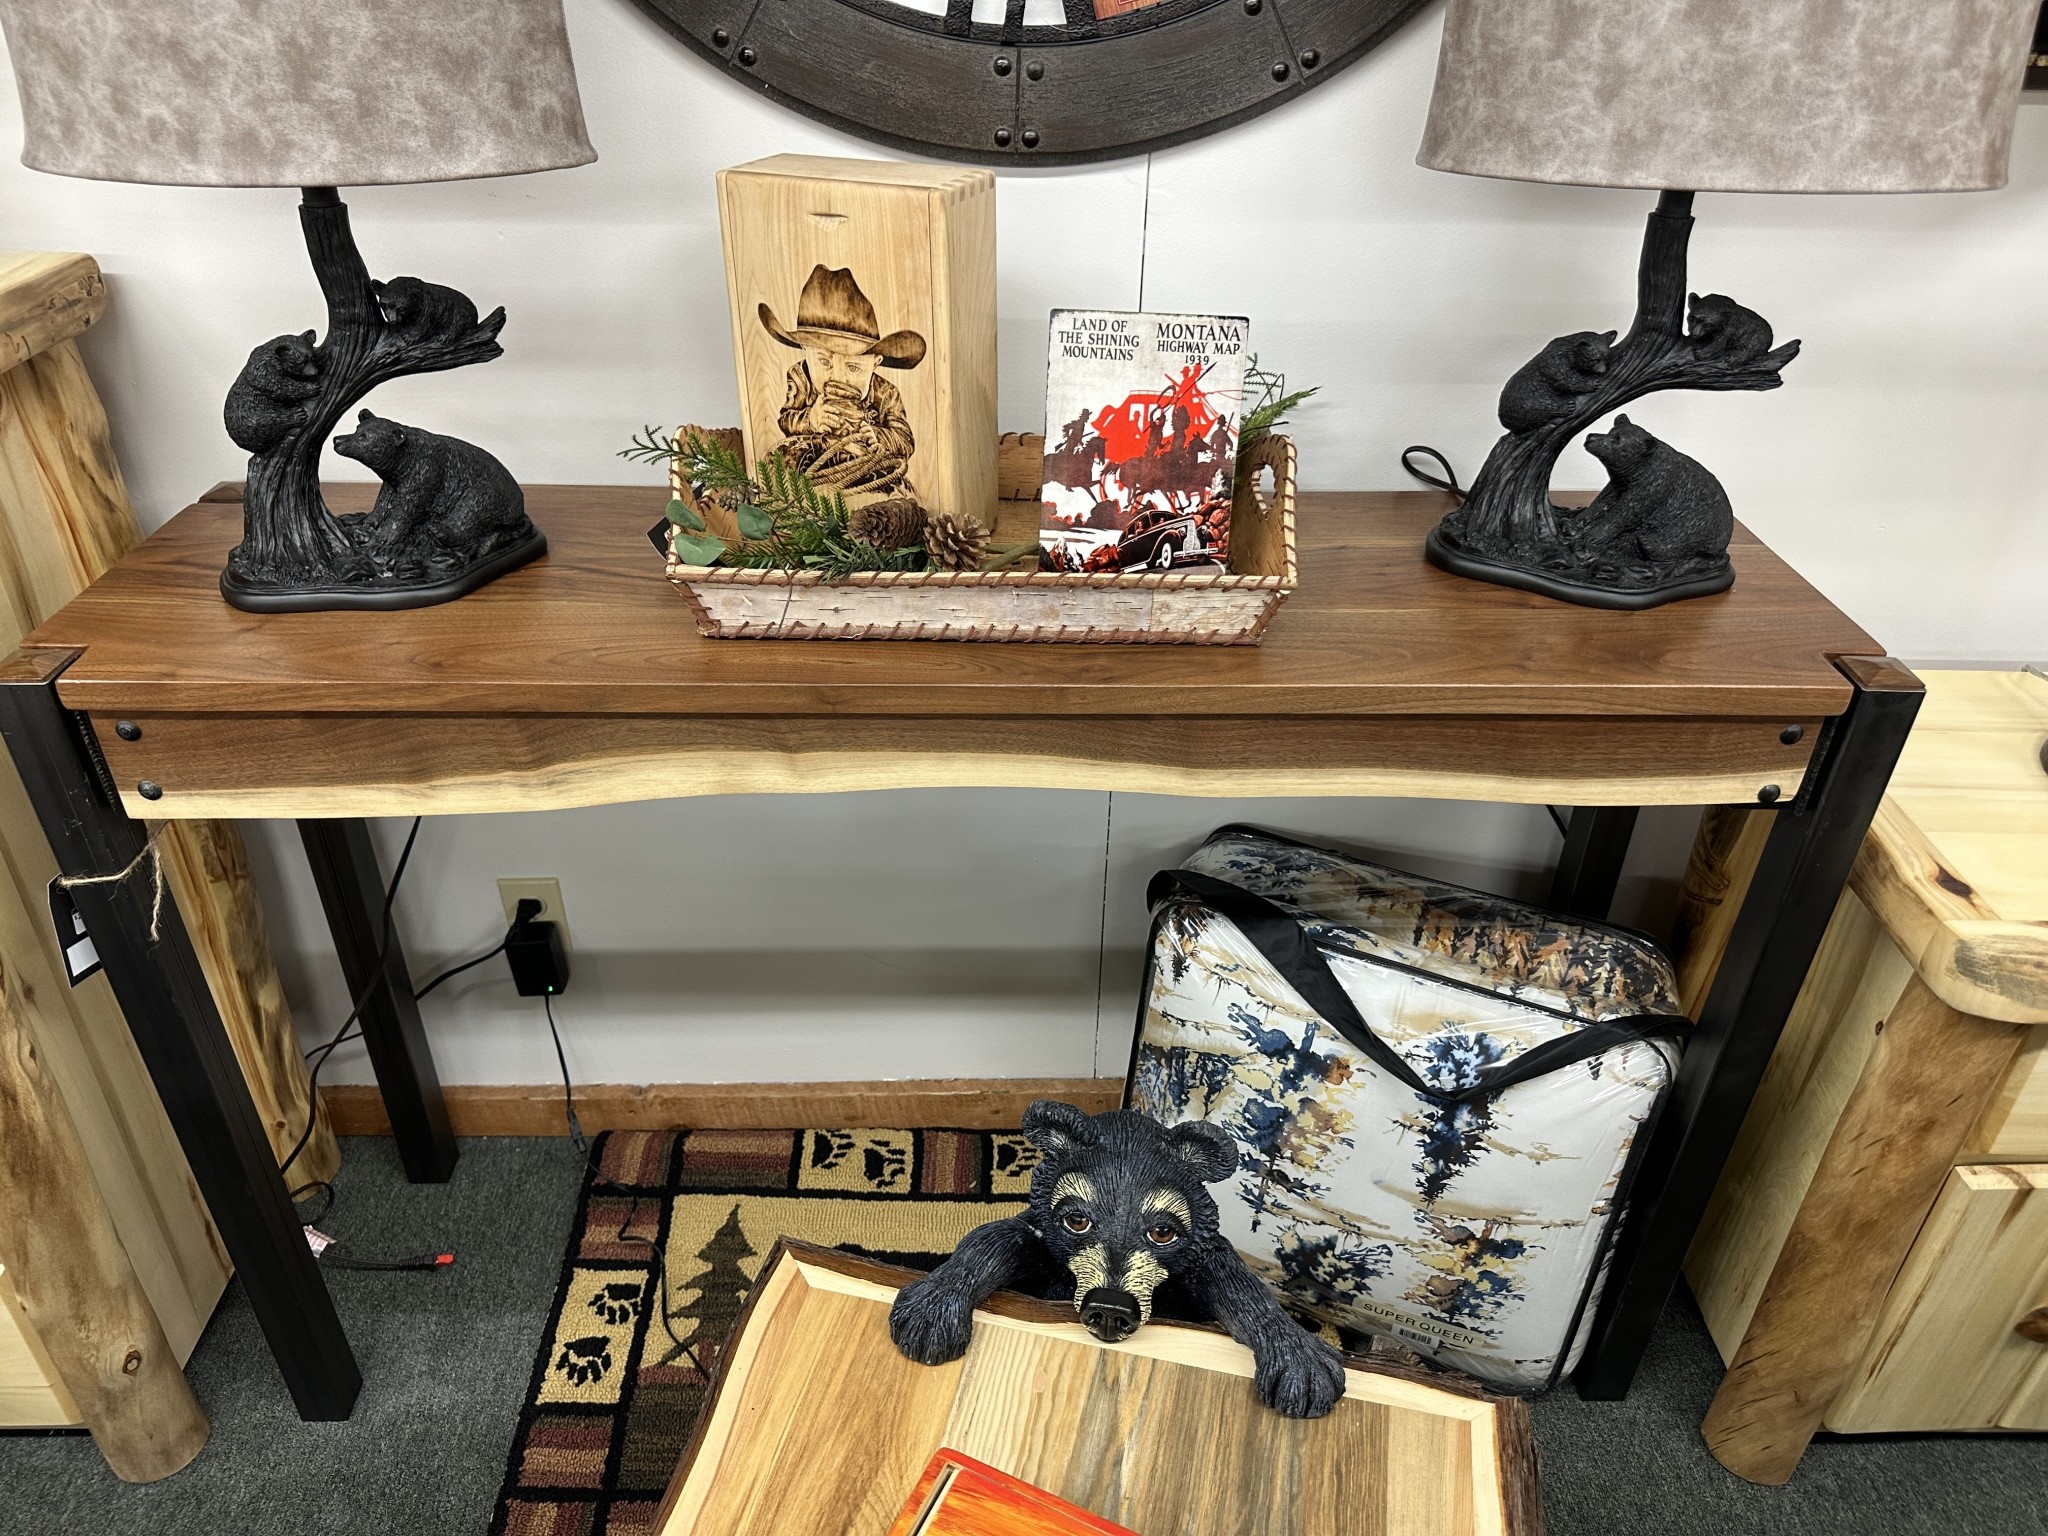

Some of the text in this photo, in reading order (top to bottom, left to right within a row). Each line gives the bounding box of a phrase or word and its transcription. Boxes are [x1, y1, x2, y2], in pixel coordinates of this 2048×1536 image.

[1073, 318, 1128, 333] LAND OF
[1156, 324, 1241, 342] MONTANA
[1058, 331, 1140, 348] THE SHINING
[1062, 346, 1134, 361] MOUNTAINS
[1157, 341, 1241, 355] HIGHWAY MAP
[1185, 355, 1209, 365] 1939
[1363, 1303, 1474, 1345] SUPER QUEEN
